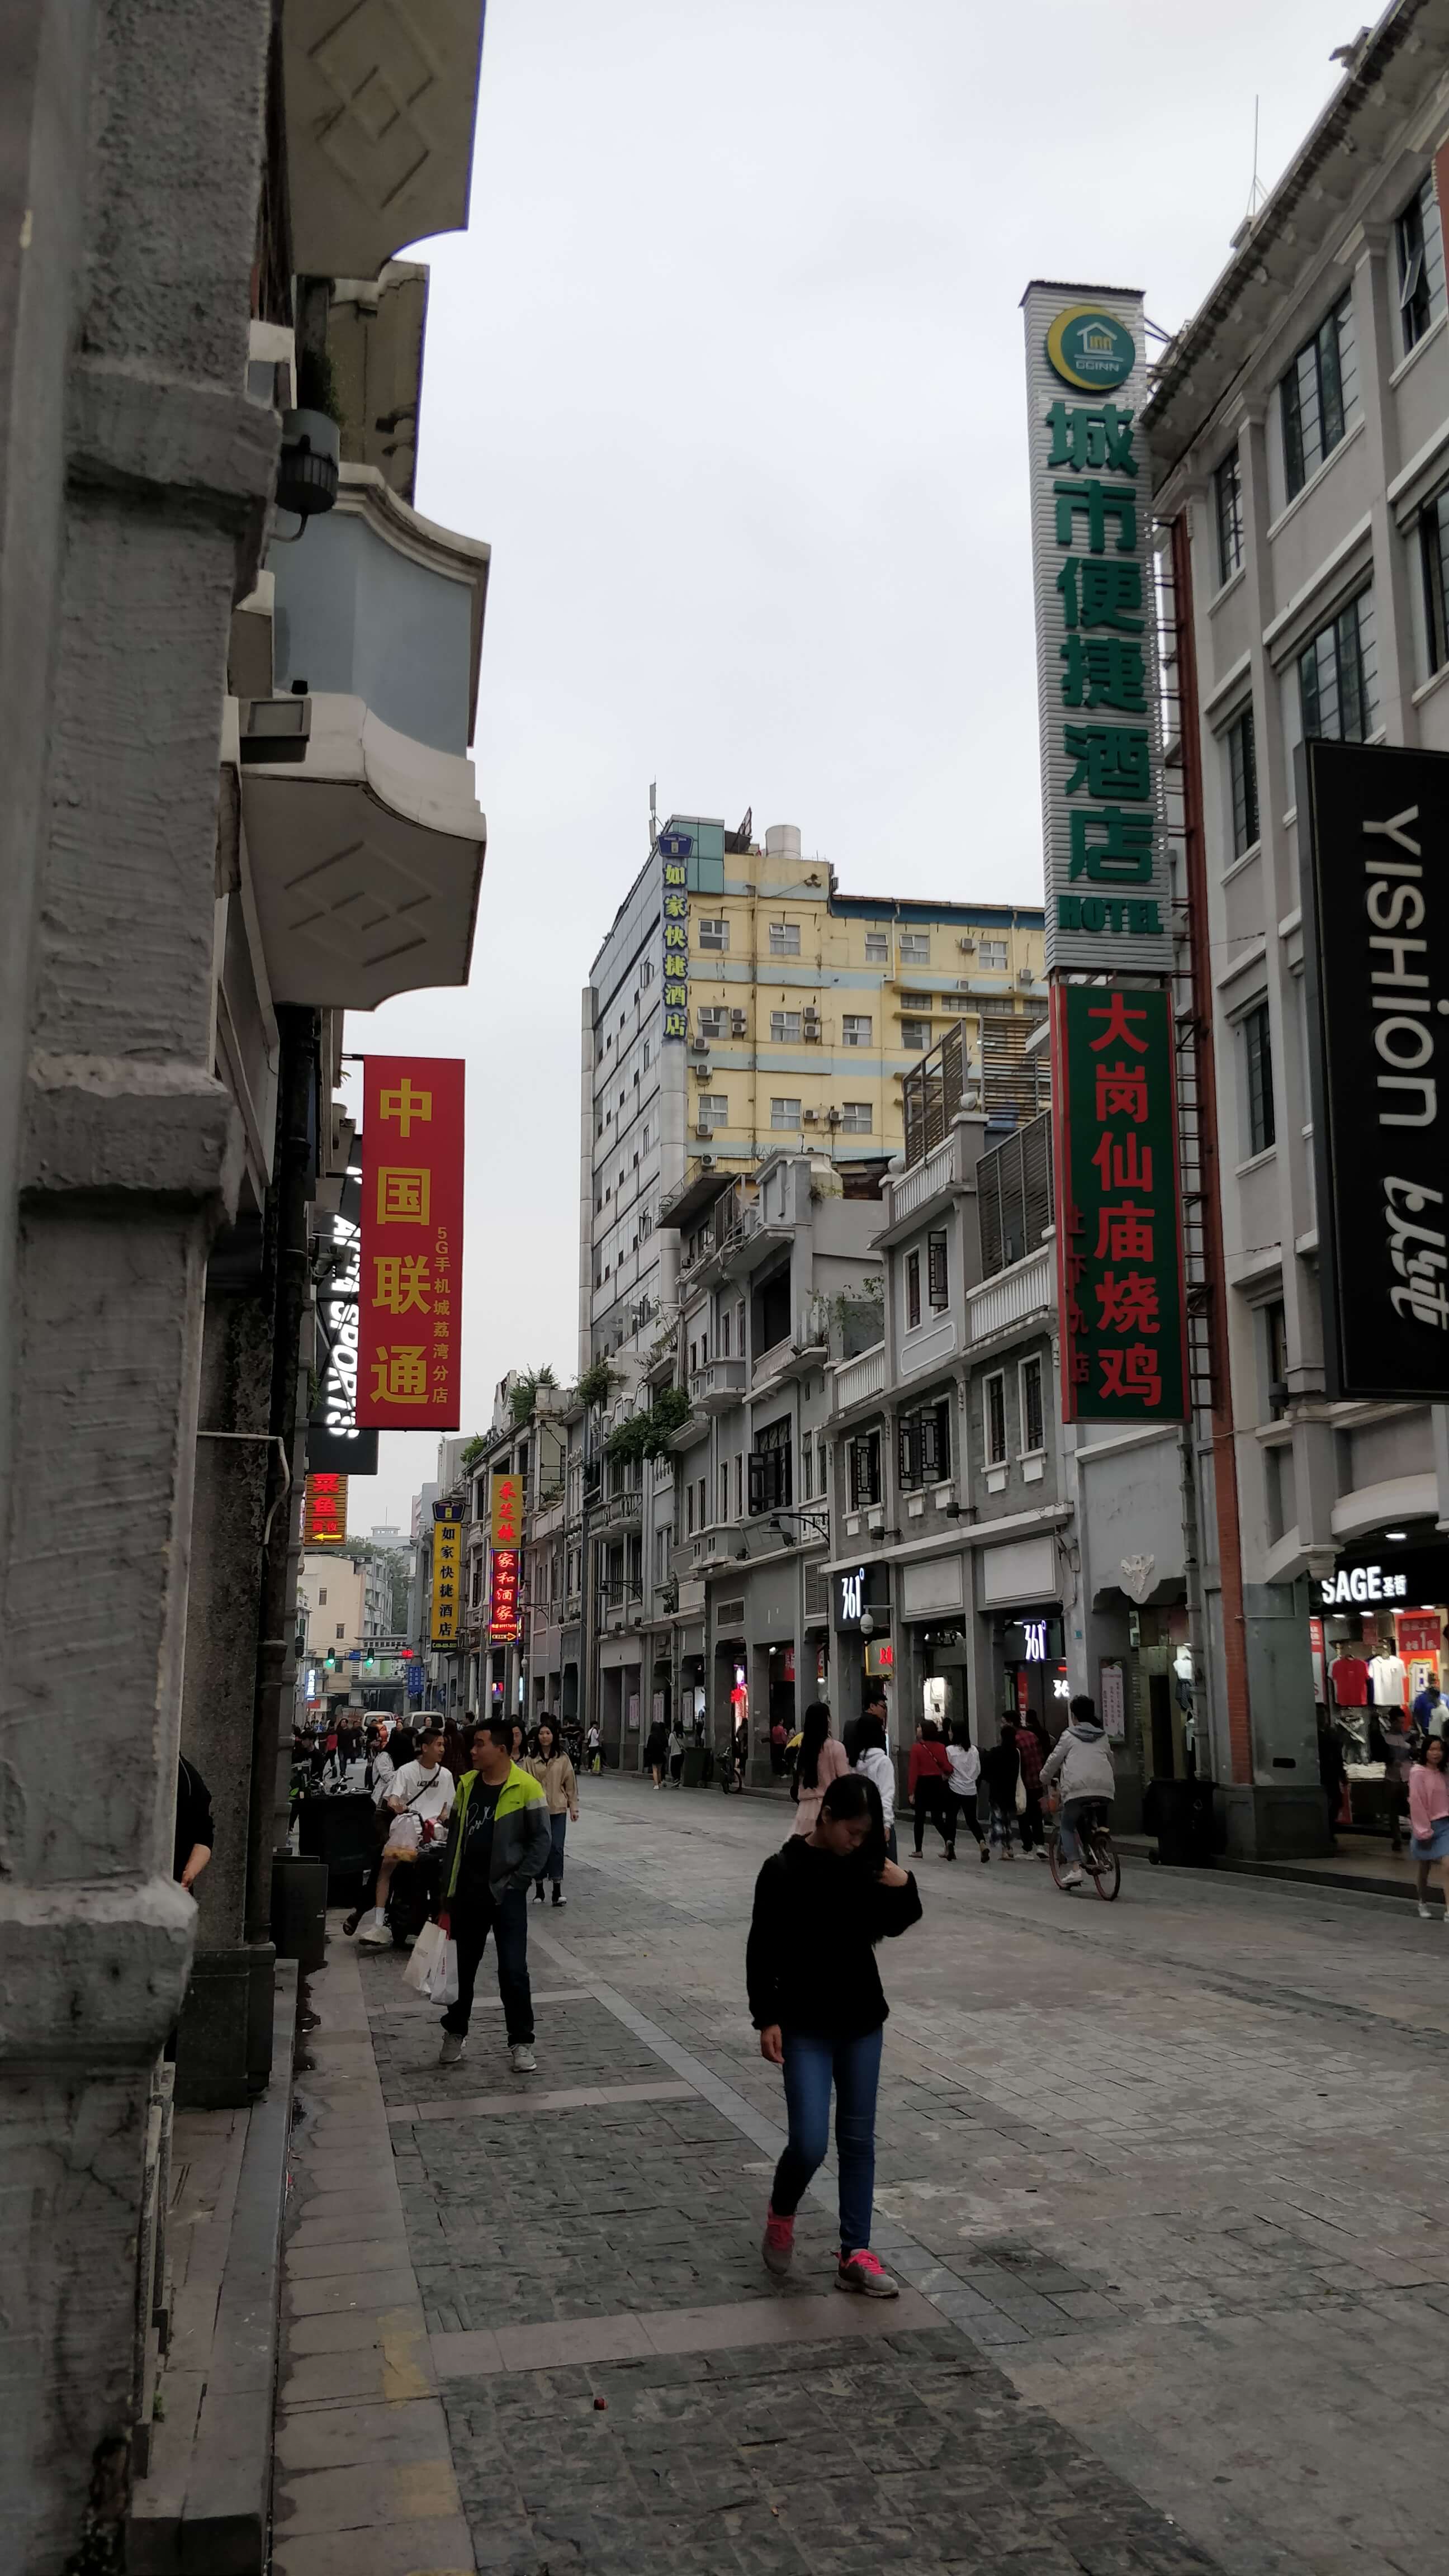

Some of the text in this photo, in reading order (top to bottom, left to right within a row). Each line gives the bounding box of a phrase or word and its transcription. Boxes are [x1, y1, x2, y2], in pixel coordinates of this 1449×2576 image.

[1046, 401, 1153, 882] 城市便捷酒店
[664, 864, 686, 1037] 如家快捷酒店
[1058, 895, 1164, 934] HOTEL
[370, 1078, 434, 1404] 中国联通
[1088, 993, 1162, 1405] 大岗仙庙烧鸡
[433, 1227, 451, 1404] 5G手机城荔湾分店
[438, 1527, 455, 1636] 如家快捷酒店
[1321, 1566, 1382, 1604] SAGE
